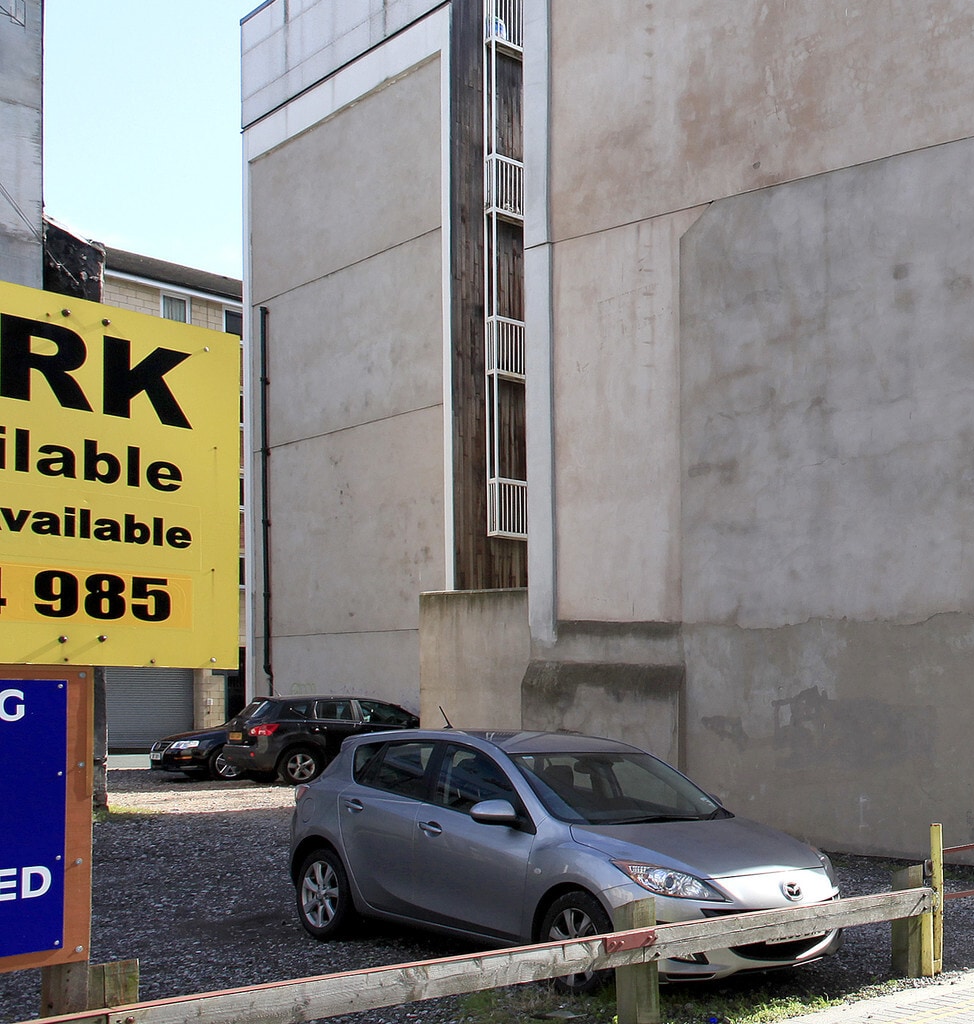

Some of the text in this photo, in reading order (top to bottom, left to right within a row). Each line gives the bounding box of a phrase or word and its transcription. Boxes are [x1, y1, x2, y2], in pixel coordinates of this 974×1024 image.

[0, 312, 193, 430] RK
[0, 506, 193, 549] vailable
[34, 570, 171, 622] 985
[0, 865, 52, 902] ED
